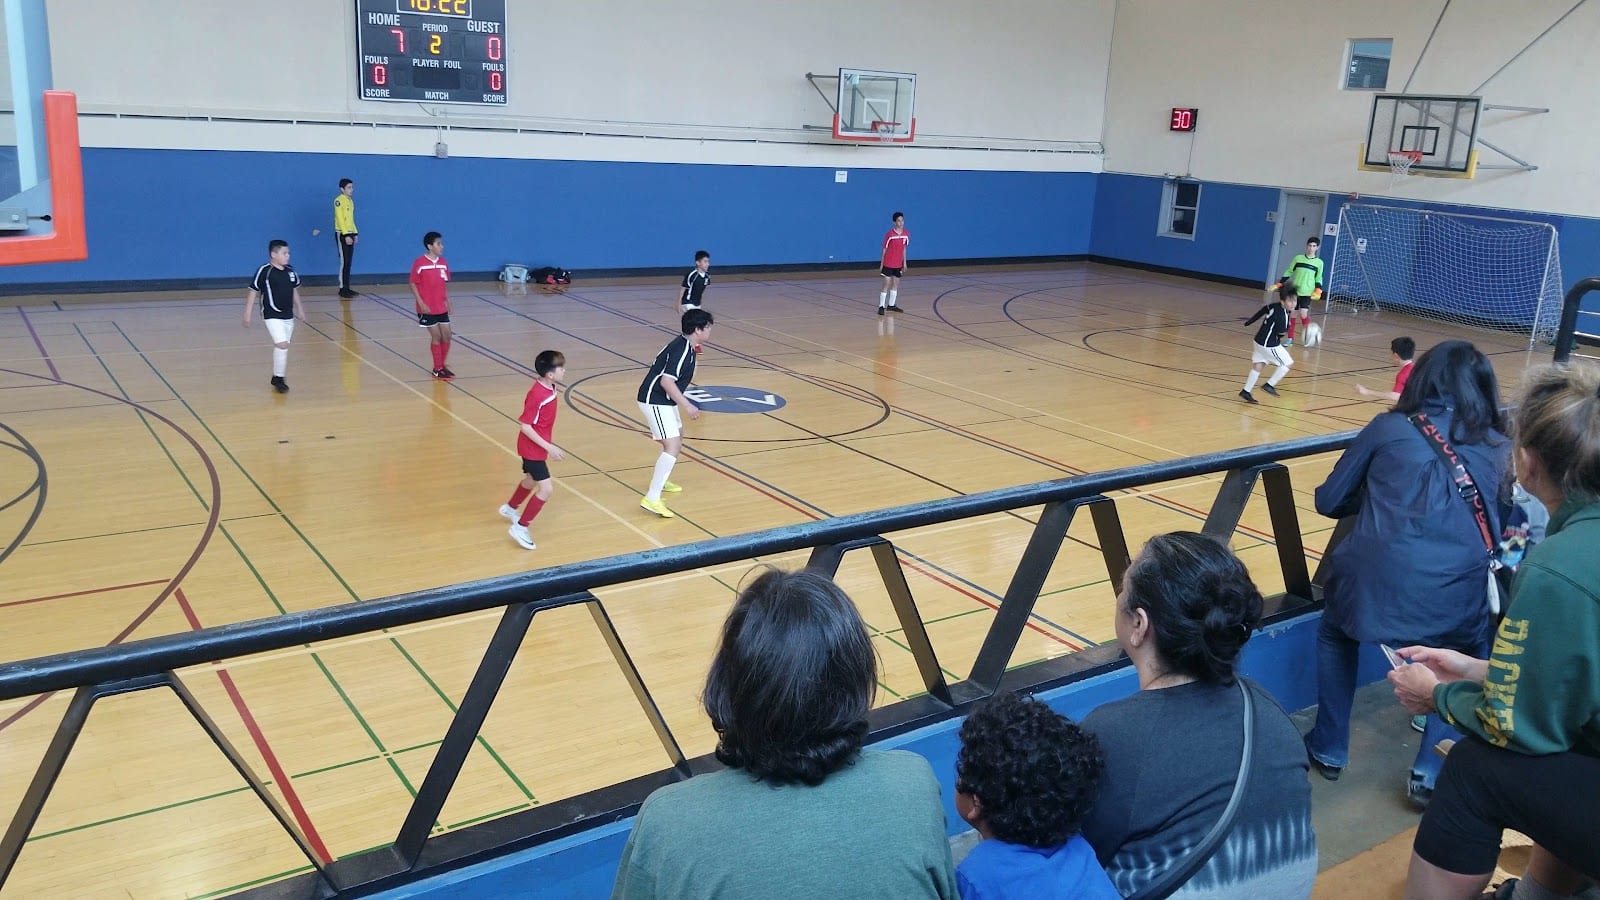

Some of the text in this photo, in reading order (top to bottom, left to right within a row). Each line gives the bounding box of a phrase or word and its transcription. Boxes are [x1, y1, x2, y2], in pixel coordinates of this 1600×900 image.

[368, 12, 400, 26] HOME
[422, 23, 449, 33] PERIOD
[467, 20, 500, 33] GUEST
[391, 30, 404, 52] 7
[430, 35, 442, 54] 2
[488, 37, 501, 60] 0
[364, 55, 389, 65] FOULS
[412, 58, 462, 69] PLAYER FOUL
[482, 62, 505, 72] FOULS
[374, 65, 386, 85] 0
[491, 73, 501, 91] 0
[365, 88, 391, 97] SCORE
[425, 91, 449, 100] MATCH
[482, 94, 505, 103] SCORE
[1172, 111, 1191, 129] 30
